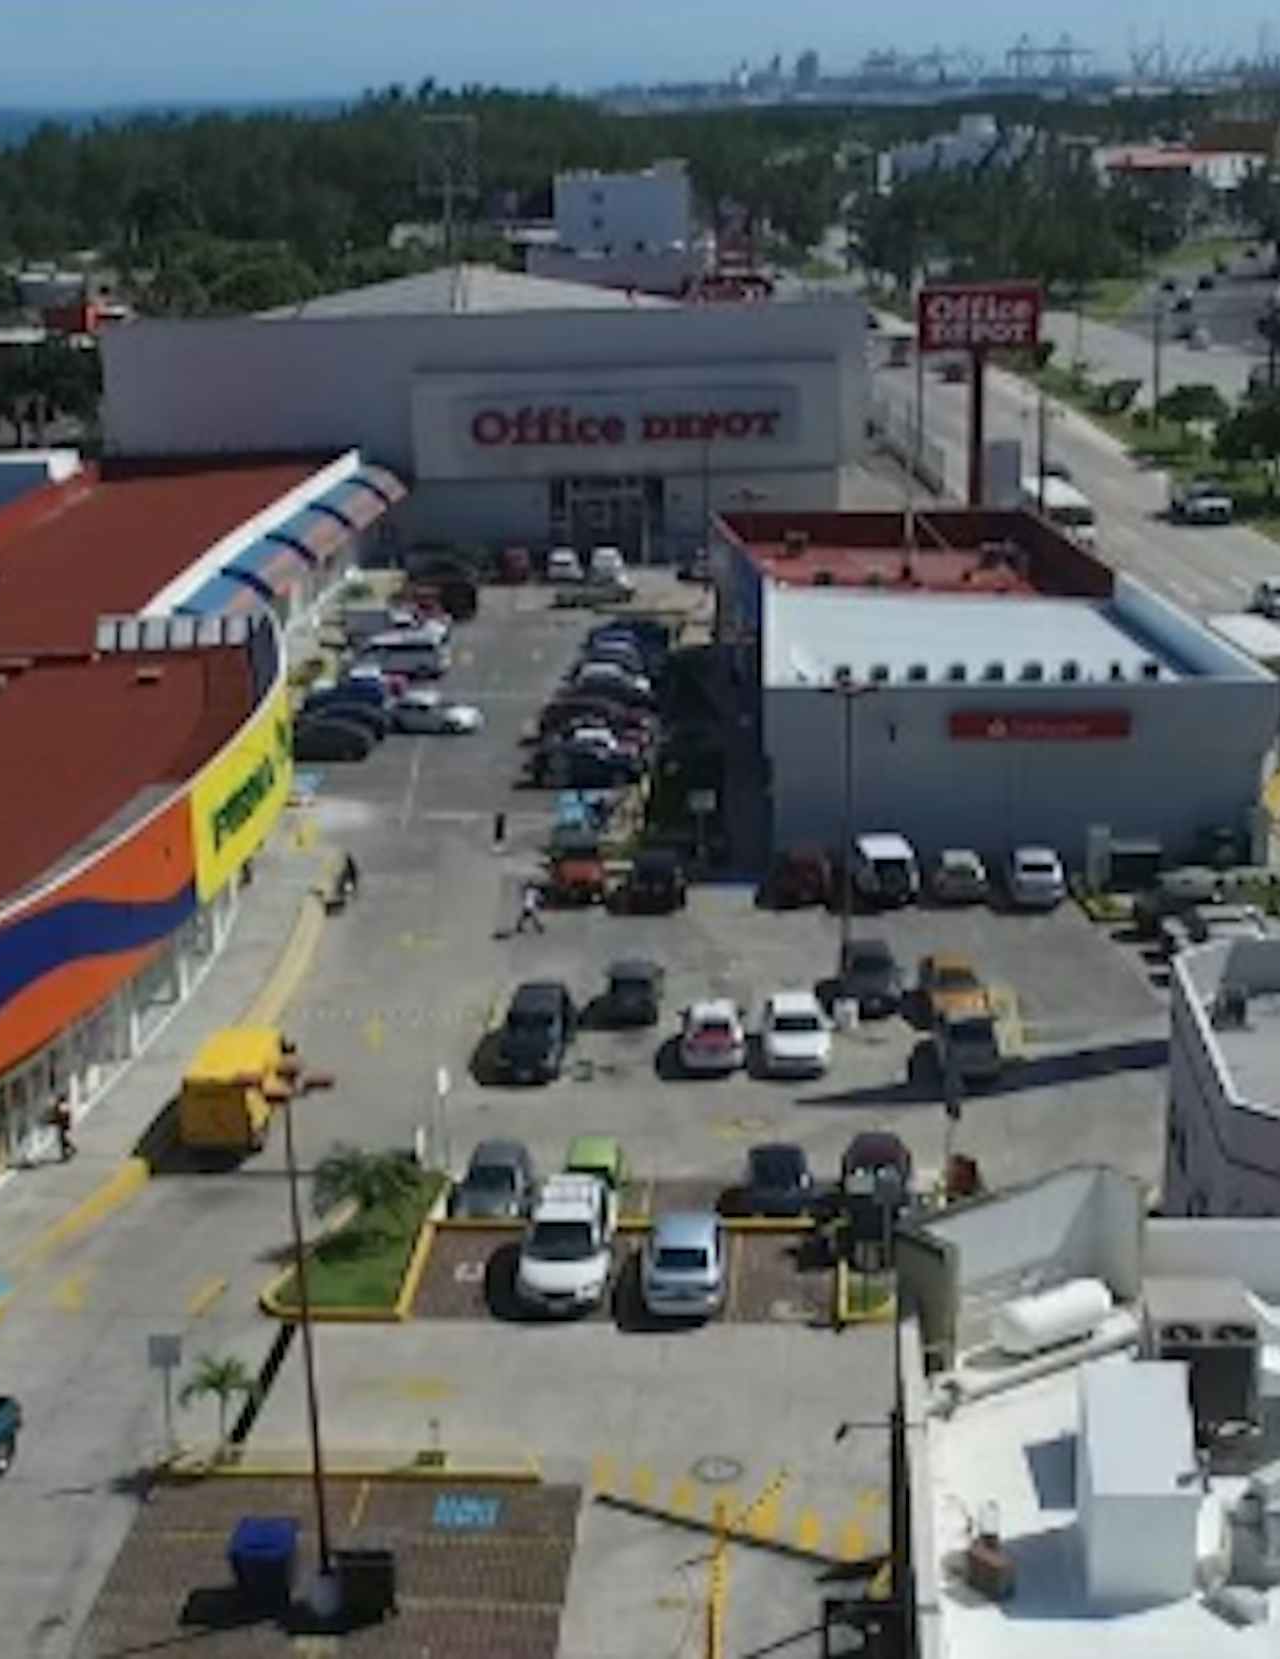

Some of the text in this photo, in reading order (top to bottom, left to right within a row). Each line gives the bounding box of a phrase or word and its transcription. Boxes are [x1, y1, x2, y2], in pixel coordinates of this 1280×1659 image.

[925, 293, 1032, 321] Office
[928, 320, 1030, 344] DEPOT
[472, 405, 780, 446] Office DEPOT
